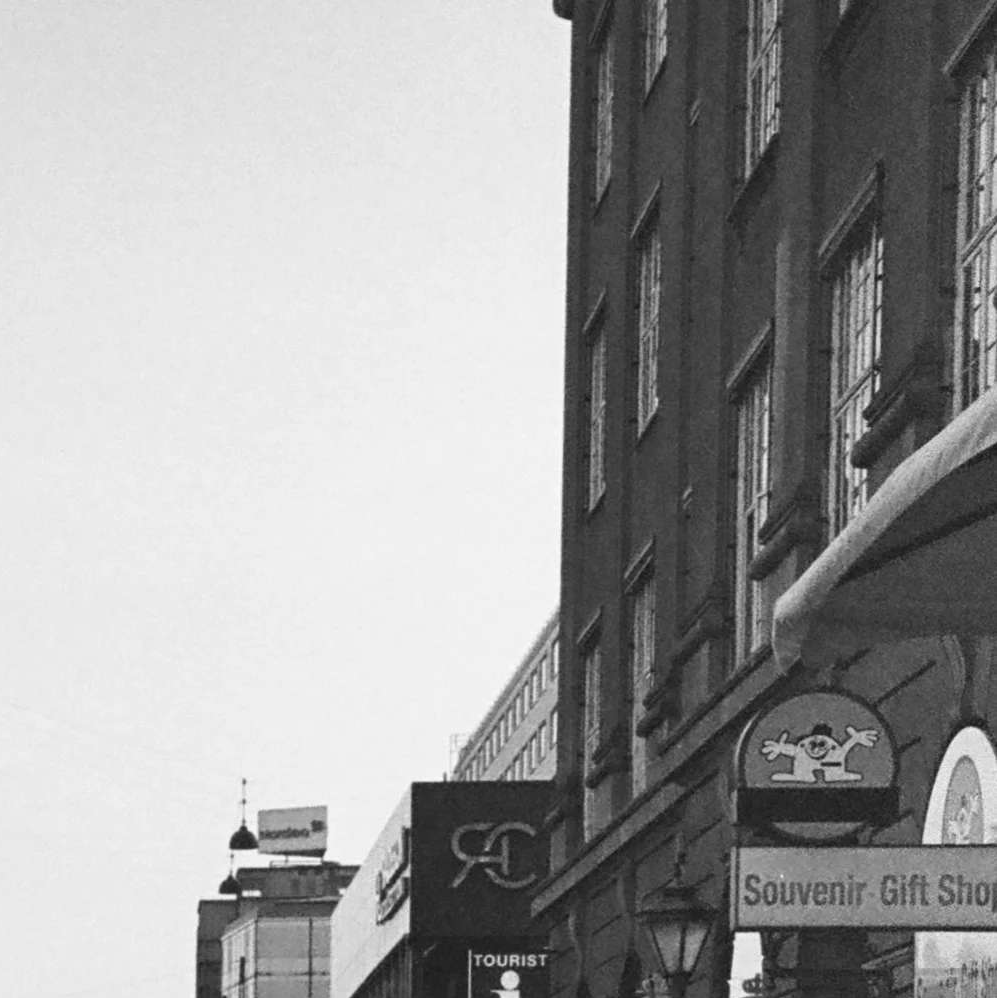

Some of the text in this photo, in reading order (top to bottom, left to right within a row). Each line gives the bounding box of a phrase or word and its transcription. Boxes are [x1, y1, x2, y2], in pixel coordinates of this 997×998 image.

[744, 873, 868, 907] Souvenir
[880, 873, 930, 907] Gift
[474, 954, 548, 967] TOURIST
